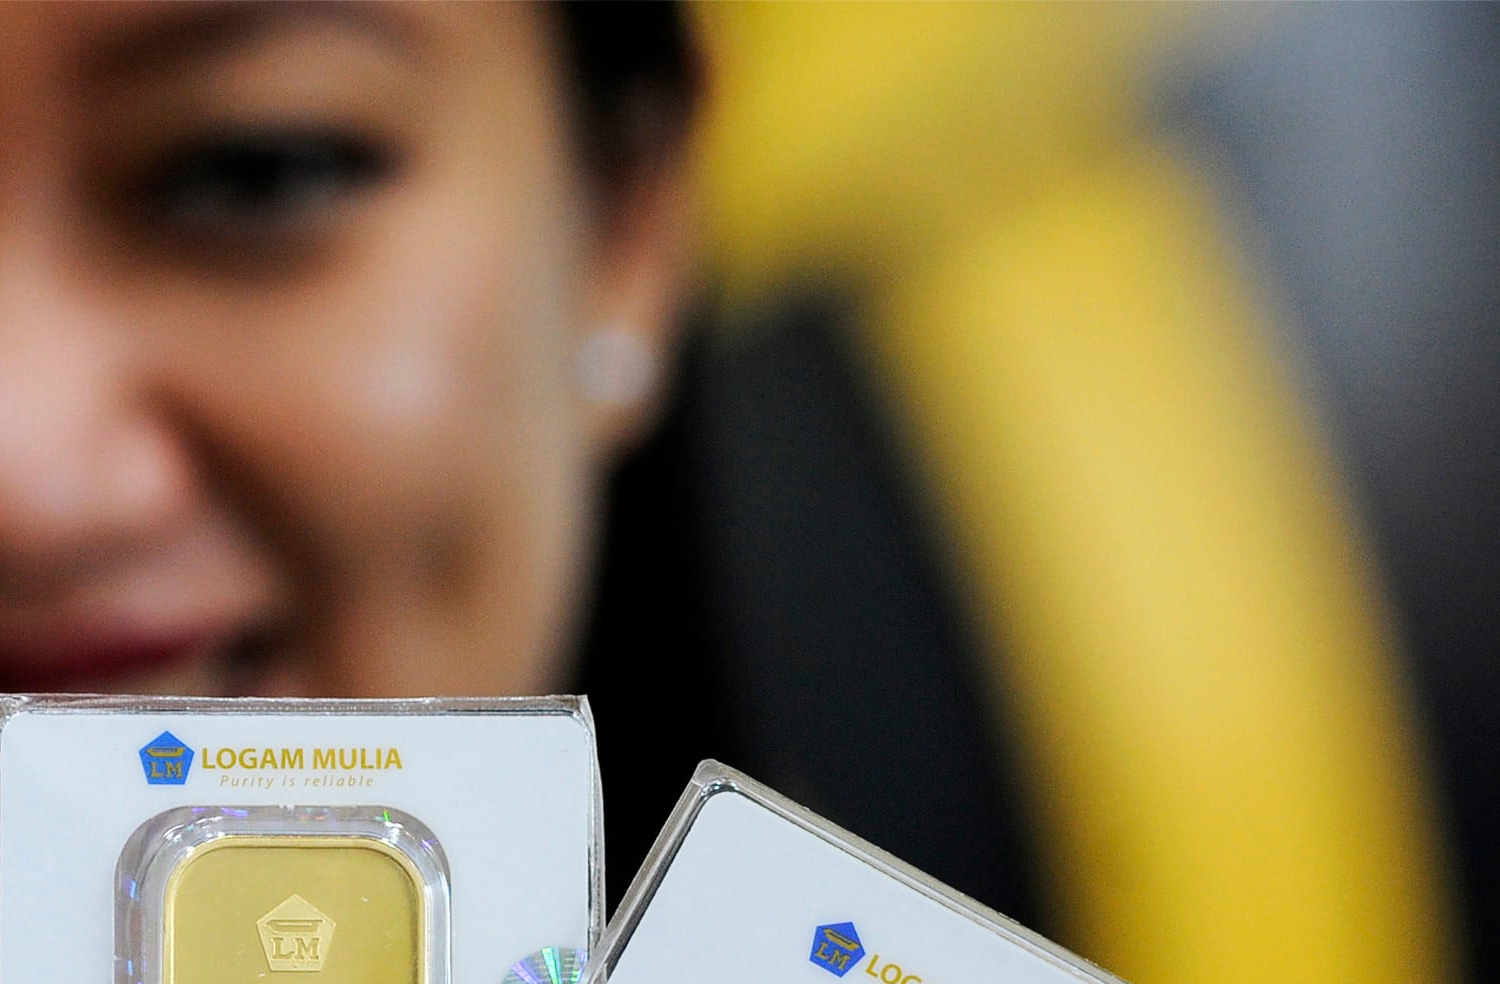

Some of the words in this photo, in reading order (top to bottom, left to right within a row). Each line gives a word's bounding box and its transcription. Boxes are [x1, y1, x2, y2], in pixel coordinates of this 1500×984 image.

[150, 761, 184, 778] LM
[201, 747, 304, 770] LOGAM
[312, 747, 402, 770] MULIA
[220, 775, 274, 789] Purity
[282, 775, 295, 787] is
[304, 775, 374, 788] reliable
[272, 937, 320, 961] LM
[816, 942, 852, 970] LM
